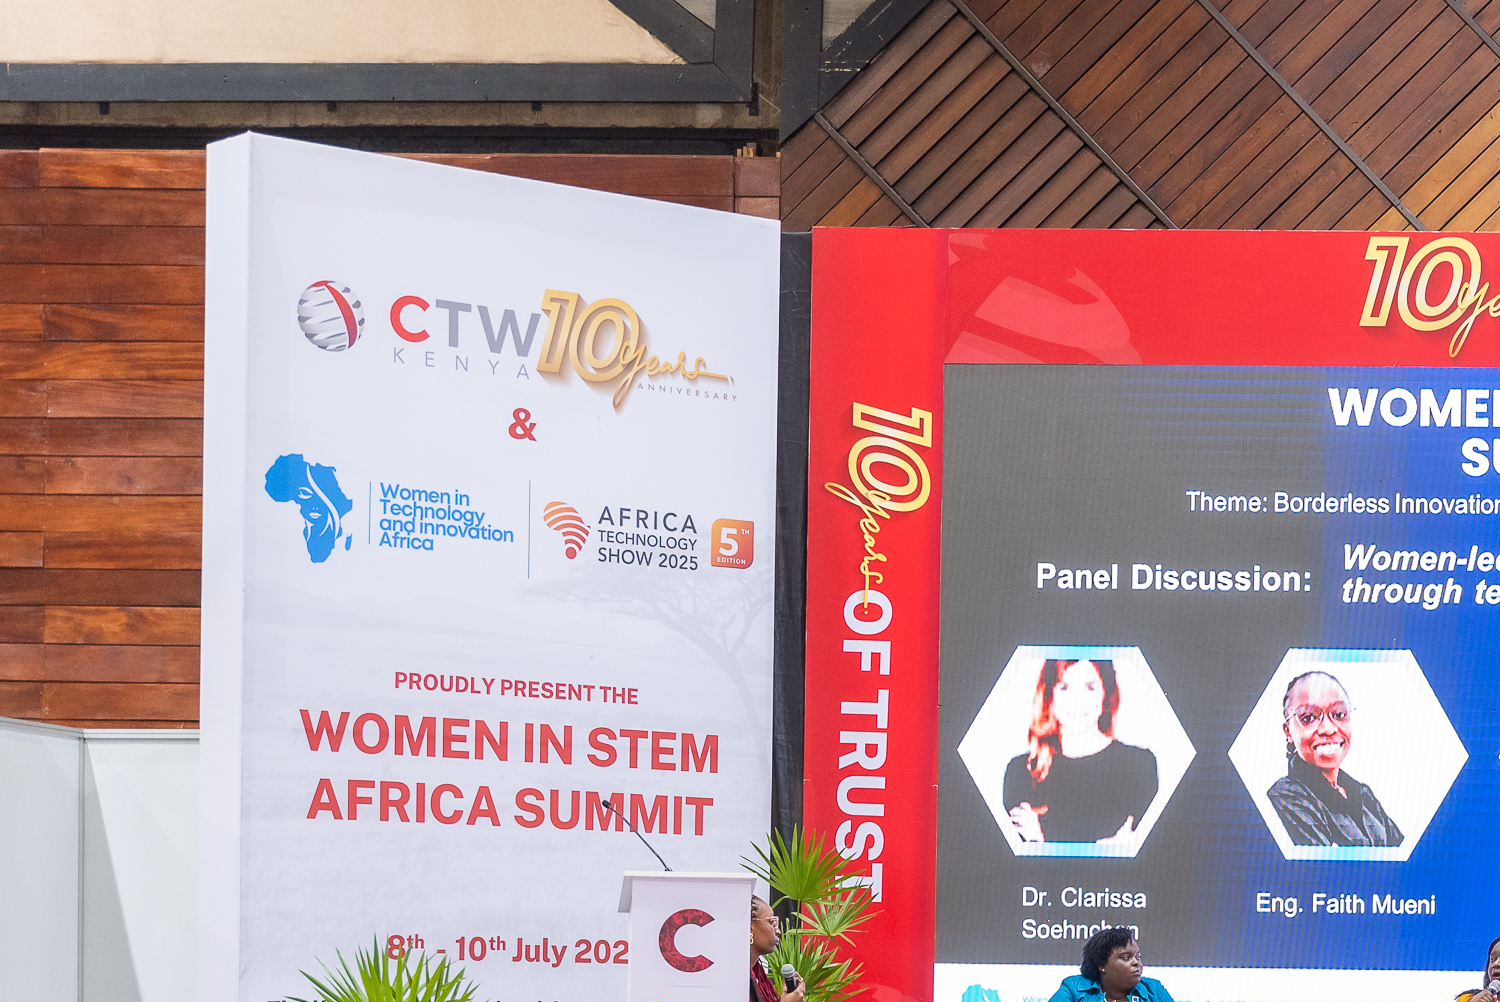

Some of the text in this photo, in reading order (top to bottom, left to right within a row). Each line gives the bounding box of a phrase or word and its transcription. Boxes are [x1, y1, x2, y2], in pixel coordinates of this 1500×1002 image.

[1359, 236, 1484, 332] 10
[389, 295, 541, 357] CTW
[393, 346, 531, 380] KENYA
[537, 288, 735, 413] 10 years
[637, 381, 738, 402] ANNIVERSARY
[508, 407, 537, 441] &
[380, 481, 470, 506] Women in
[1186, 491, 1267, 513] Theme:
[1274, 492, 1390, 514] Borderless
[380, 499, 486, 529] Technology
[380, 515, 514, 543] and innovation
[598, 506, 697, 534] AFRICA
[379, 531, 434, 551] Africa
[598, 529, 697, 551] TECHNOLOGY
[598, 546, 699, 571] SHOW 2025
[716, 556, 746, 565] EDITION
[1037, 563, 1312, 593] Panel Discussion:
[1342, 579, 1462, 611] through
[824, 401, 933, 903] 10 years OF TRUST
[395, 671, 639, 706] PROUDLY PRESENT THE
[300, 709, 719, 774] WOMEN IN STEM
[307, 778, 714, 836] AFRICA SUMMIT
[1022, 886, 1147, 909] Dr. Clarissa
[1256, 893, 1437, 918] Eng. Faith Mueni
[1022, 918, 1139, 941] Soehncn
[455, 936, 506, 962] 10th
[512, 938, 567, 968] July
